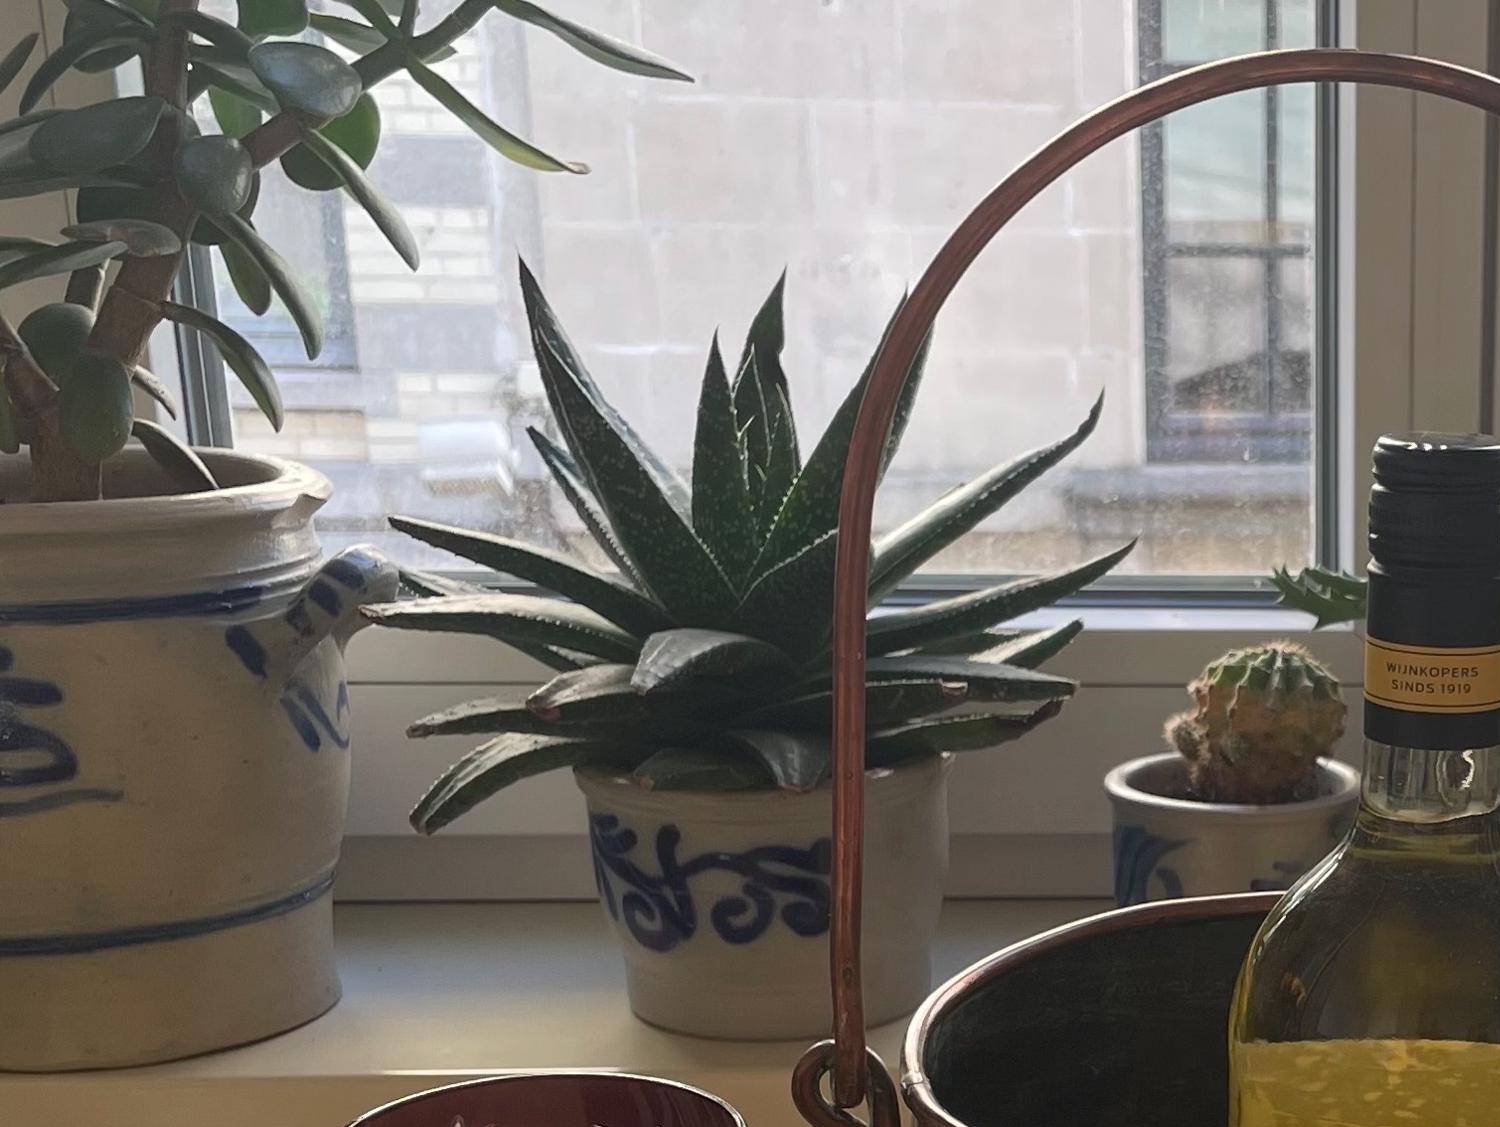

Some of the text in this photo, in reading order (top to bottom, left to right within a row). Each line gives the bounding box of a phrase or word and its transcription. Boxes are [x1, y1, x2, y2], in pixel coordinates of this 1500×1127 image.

[1386, 662, 1479, 678] WIJNKOPERS
[1391, 679, 1472, 695] SINDS 1919
